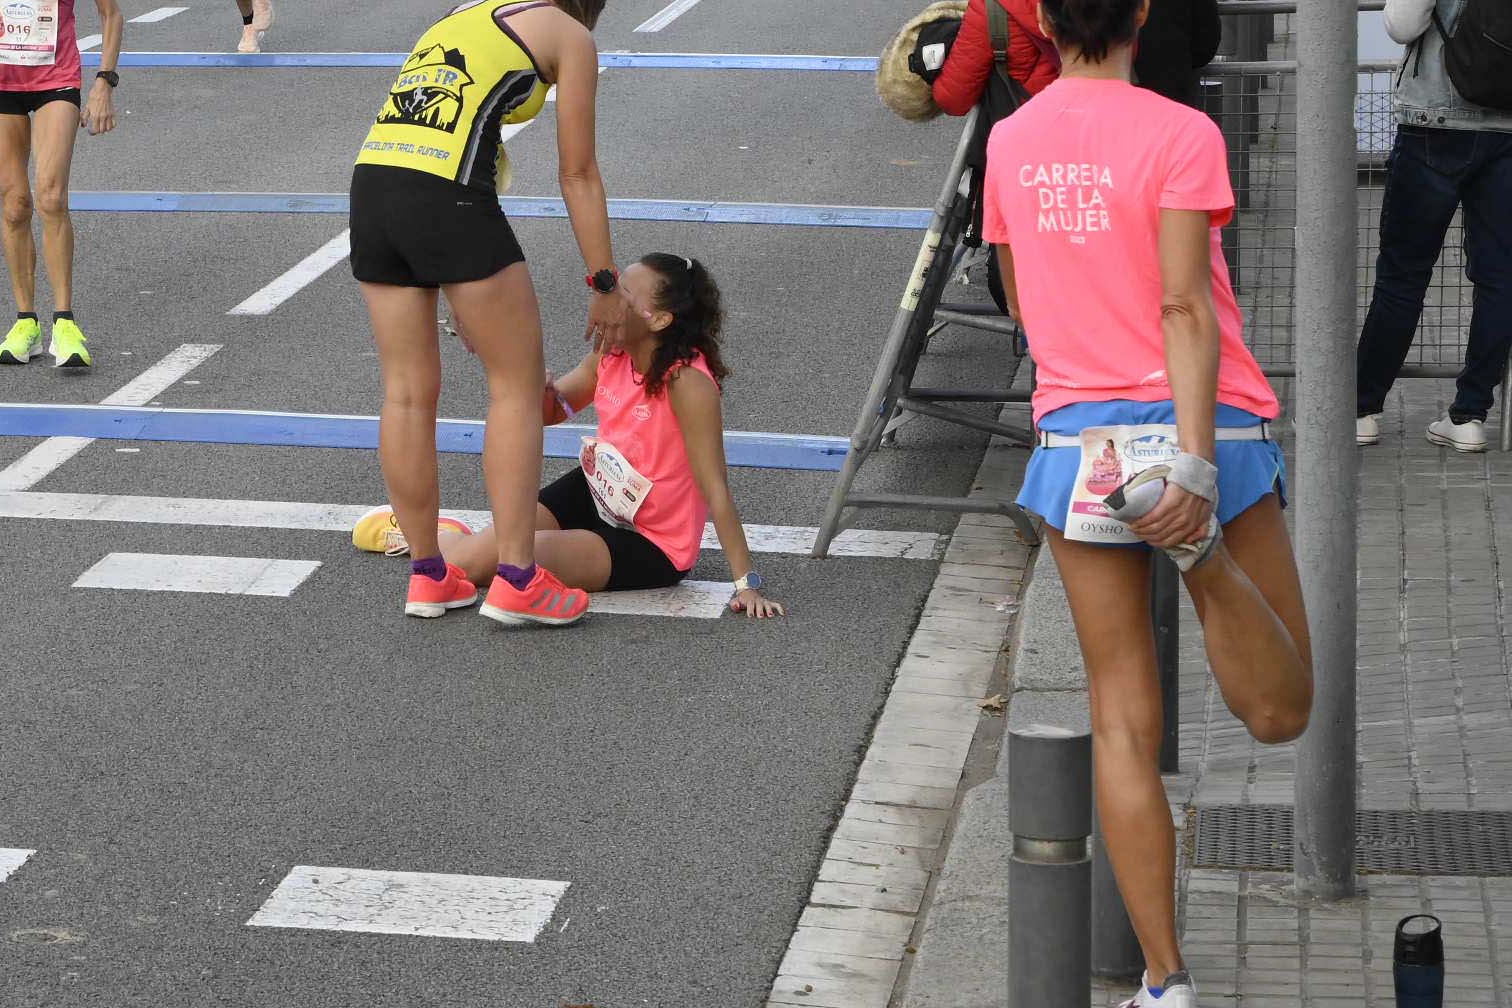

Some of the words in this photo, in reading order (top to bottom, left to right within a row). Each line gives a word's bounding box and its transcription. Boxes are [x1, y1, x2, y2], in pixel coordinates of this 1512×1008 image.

[7, 24, 31, 34] 016
[1039, 187, 1067, 209] DE
[1078, 189, 1106, 209] LA
[1038, 210, 1112, 233] MUJER
[596, 470, 615, 497] 016
[1080, 521, 1124, 536] OYSHO
